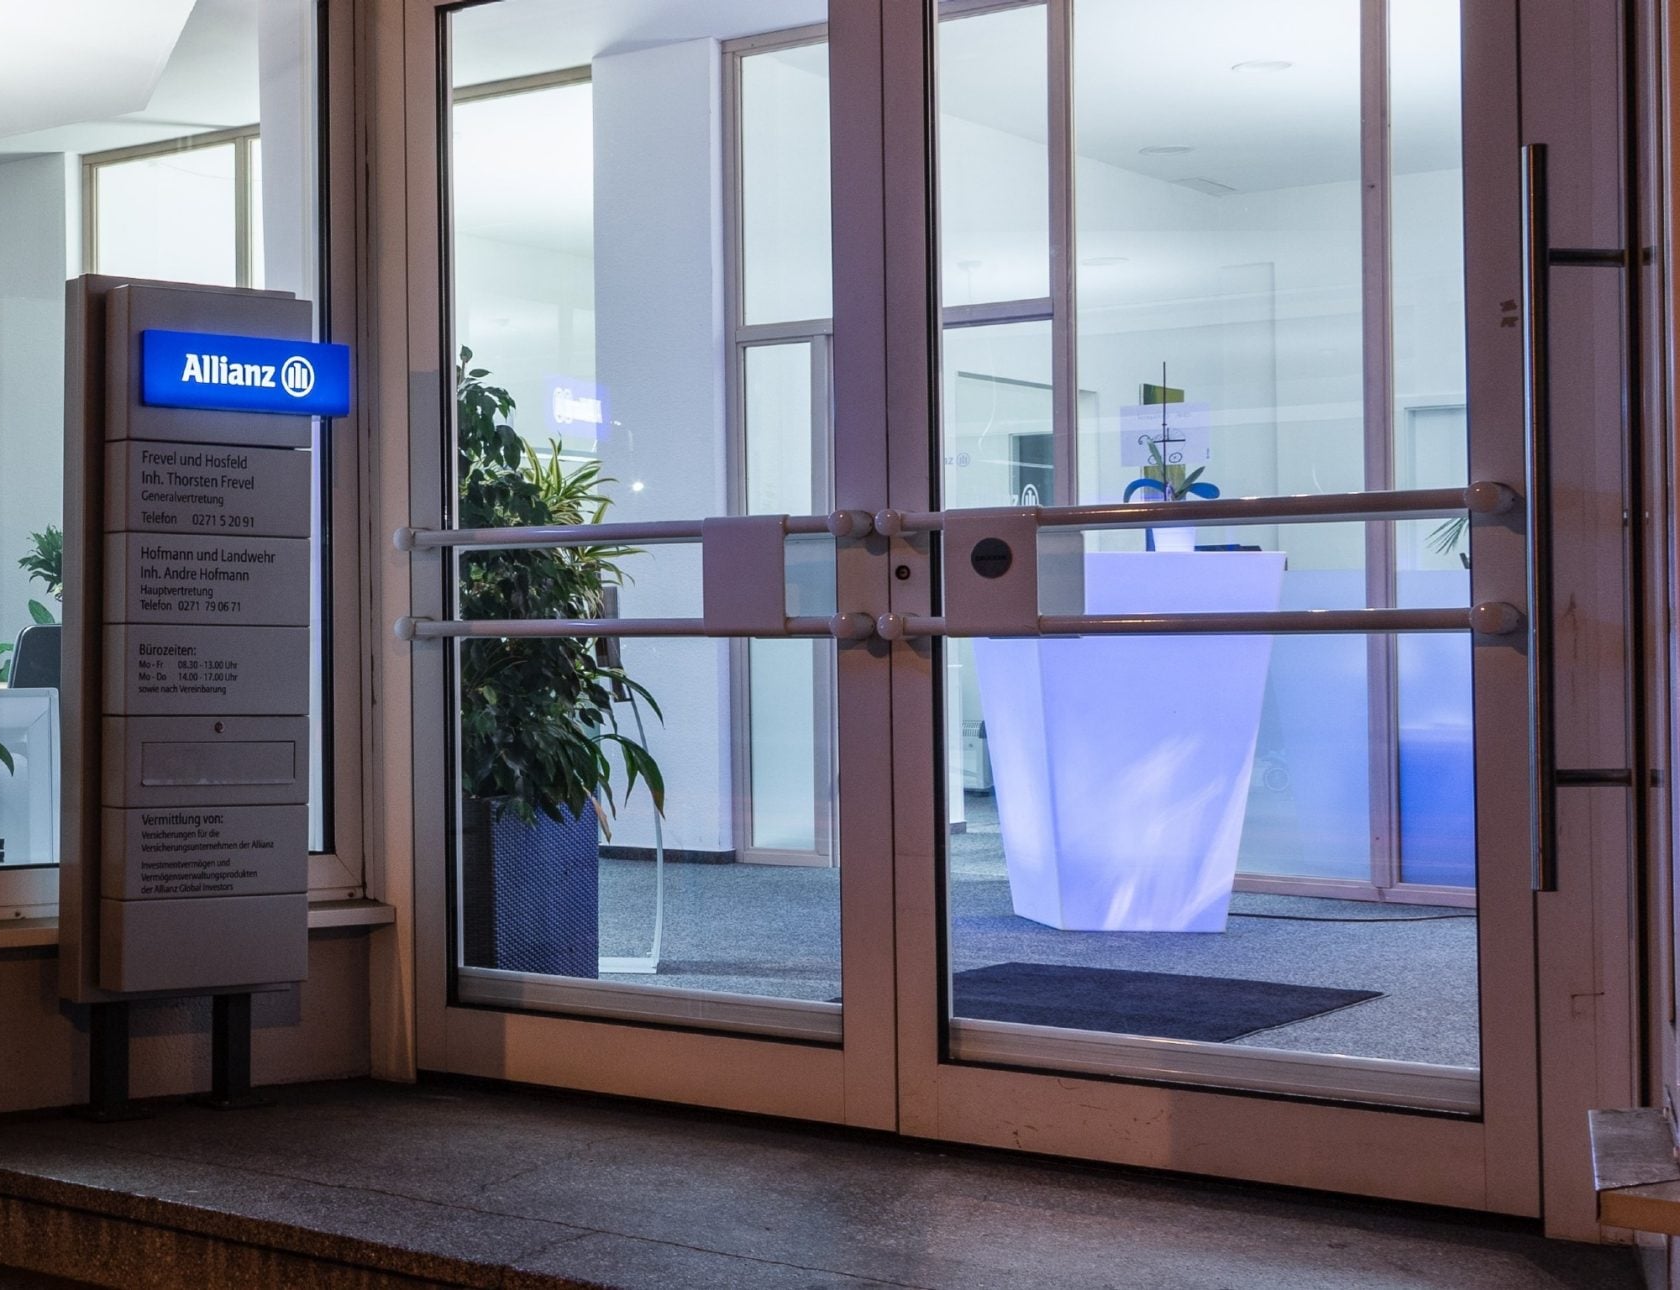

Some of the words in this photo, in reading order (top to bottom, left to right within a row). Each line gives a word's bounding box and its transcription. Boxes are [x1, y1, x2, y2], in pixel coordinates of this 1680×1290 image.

[182, 353, 276, 388] Allianz
[142, 450, 177, 465] Frevel
[180, 453, 202, 467] und
[205, 454, 248, 469] Hosfeld
[142, 471, 164, 485] Inh.
[167, 472, 218, 488] Thorsten
[221, 475, 255, 490] Frevel
[141, 490, 224, 507] Generalvertretung
[142, 512, 177, 524] Telefon
[192, 513, 216, 526] 0271
[141, 547, 193, 561] Hofmann
[197, 549, 218, 562] und
[221, 549, 276, 563] Landwehr
[140, 566, 161, 579] Inh.
[164, 567, 197, 580] Andre
[200, 568, 249, 581] Hofmann
[140, 585, 214, 599] Hauptvertretung
[140, 600, 172, 611] Telefon
[178, 601, 200, 612] 0271
[139, 643, 197, 656] Bürozeiten:
[139, 660, 151, 669] Mo
[156, 660, 164, 669] Fr
[225, 661, 238, 669] Uhr
[139, 672, 151, 681] Mo
[156, 672, 167, 681] Do
[225, 672, 238, 681] Uhr
[138, 685, 159, 693] sowie
[160, 684, 178, 693] nach
[180, 684, 227, 695] Vereinbarung
[141, 813, 201, 827] Vermittlung
[203, 814, 223, 824] von:
[141, 830, 196, 840] Versicherungen
[197, 829, 207, 838] für
[209, 829, 219, 838] die
[141, 841, 238, 853] Versicherungsunternehmen
[239, 840, 250, 849] der
[251, 840, 274, 849] Allianz
[141, 859, 215, 870] Investmentvermögen
[217, 858, 230, 867] und
[141, 870, 258, 882] Vermögensverwaltungsprodukten
[141, 885, 152, 894] der
[154, 884, 178, 894] Allianz
[179, 884, 202, 893] Global
[202, 883, 234, 892] Investors
